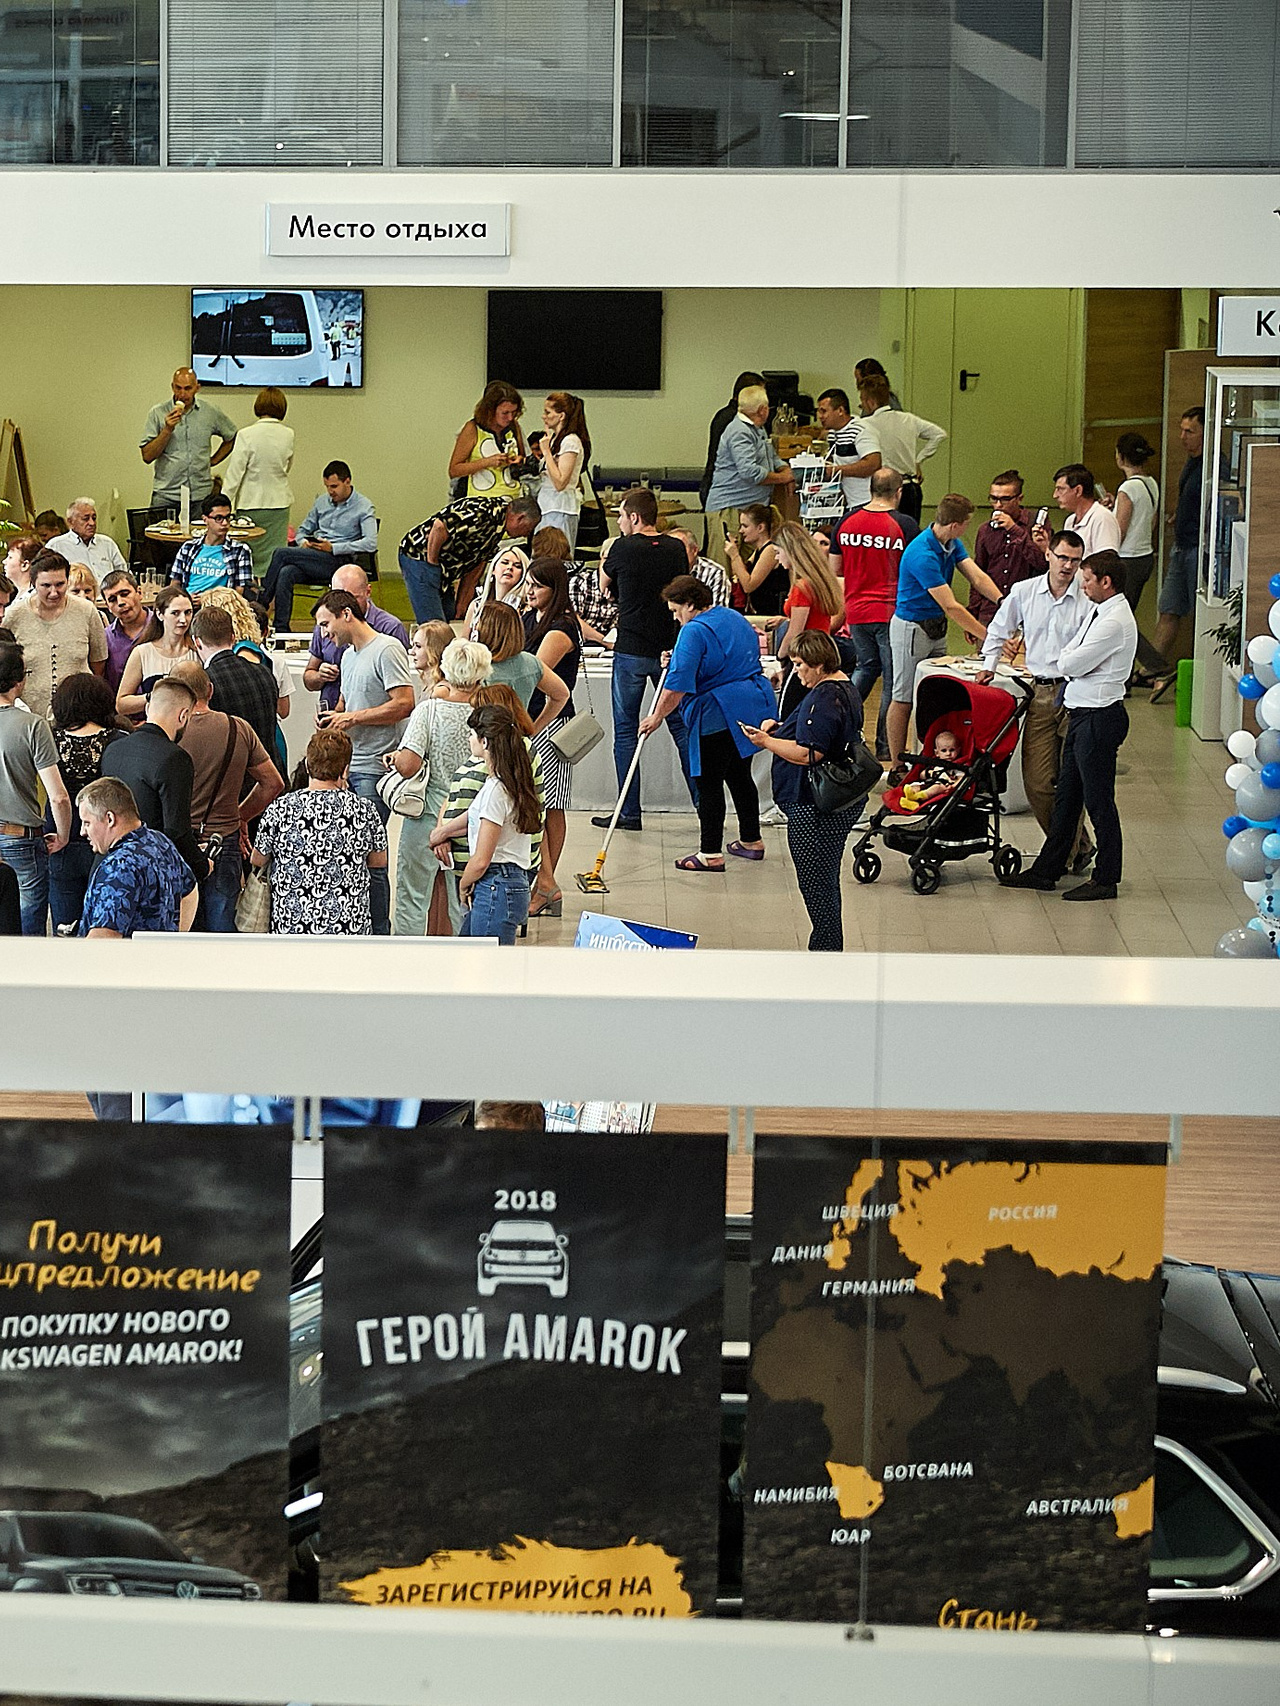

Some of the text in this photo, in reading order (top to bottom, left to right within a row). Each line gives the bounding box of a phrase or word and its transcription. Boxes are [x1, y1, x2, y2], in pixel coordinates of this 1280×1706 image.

[288, 215, 487, 241] Место отдыха
[839, 533, 904, 551] RUSSIA
[494, 1189, 557, 1211] 2018
[822, 1202, 899, 1221] ШВЕЦИЯ
[988, 1204, 1058, 1221] РОССИЯ
[28, 1218, 162, 1263] Получи
[771, 1244, 834, 1263] ДАНИЯ
[822, 1278, 917, 1297] ГЕРМАНИЯ
[1, 1312, 119, 1340] ПОКУПКУ
[123, 1308, 231, 1335] НОВОГО
[356, 1306, 688, 1375] ГЕРОЙ AMAROK
[125, 1339, 244, 1366] AMAROK!
[883, 1461, 975, 1481] БОТСВАНА
[753, 1485, 840, 1504] НАМИБИЯ
[1026, 1498, 1129, 1516] АВСТРАЛИЯ
[830, 1528, 872, 1545] ЮАР
[375, 1575, 652, 1604] ЗАРЕГИСТРИРУЙСЯ НА
[938, 1598, 1039, 1632] Стань
